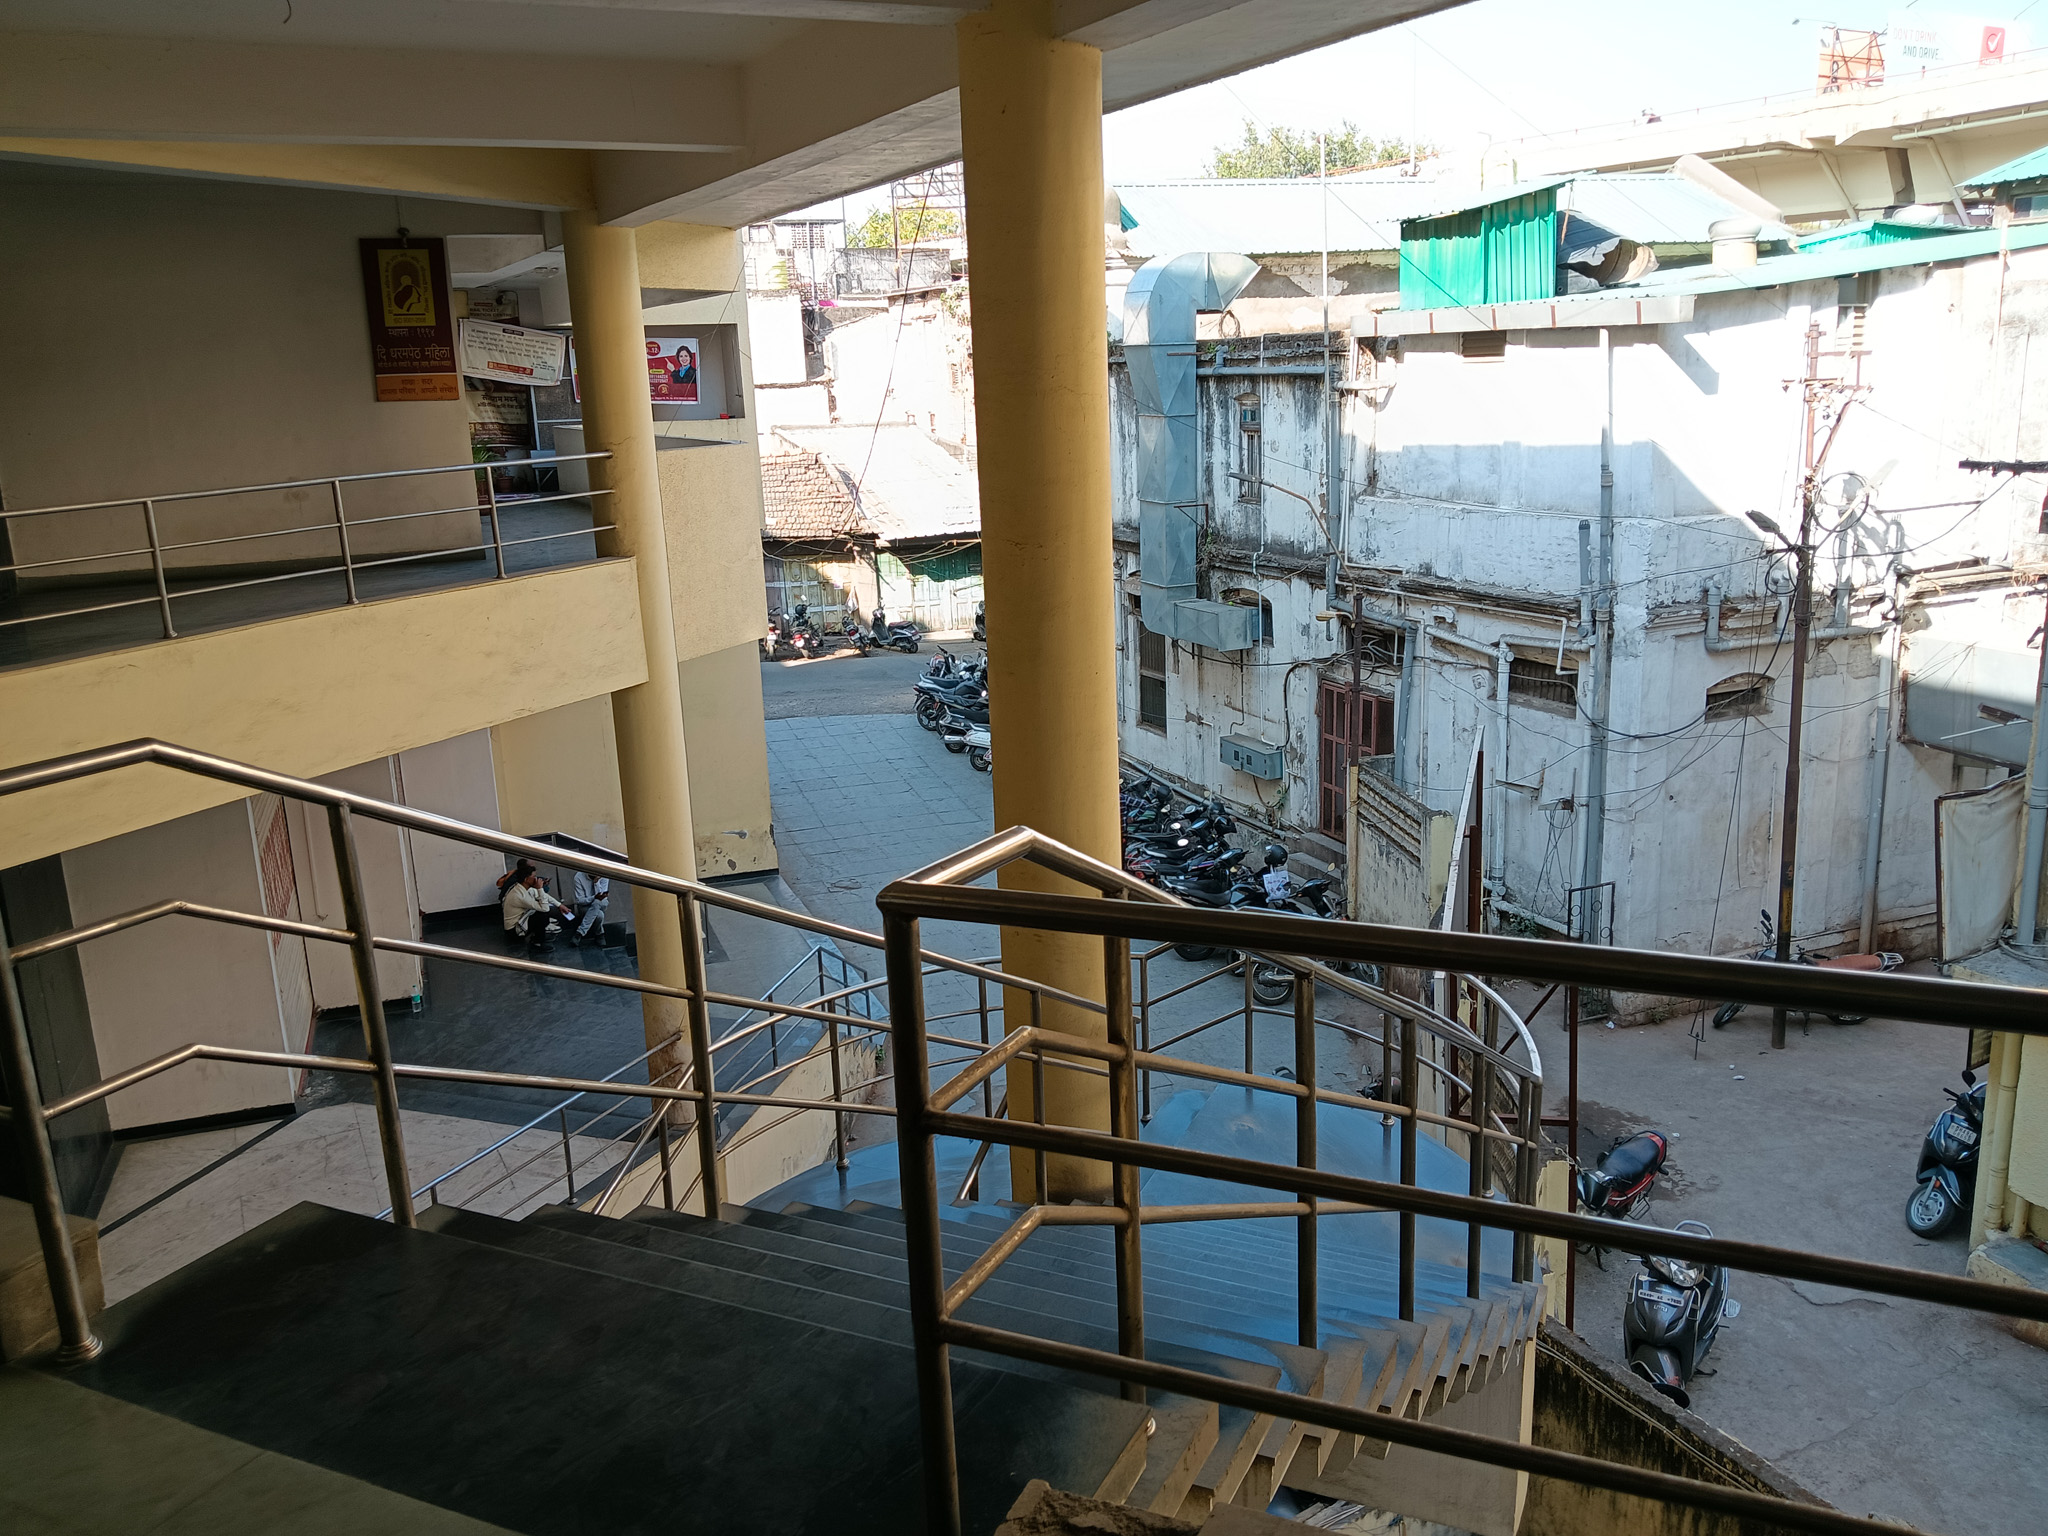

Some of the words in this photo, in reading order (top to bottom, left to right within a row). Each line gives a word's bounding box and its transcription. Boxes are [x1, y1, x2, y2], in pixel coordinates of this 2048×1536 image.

[1902, 45, 1917, 57] AND
[376, 344, 387, 361] दि
[390, 343, 421, 360] धरमपेठ
[424, 343, 450, 361] महिला
